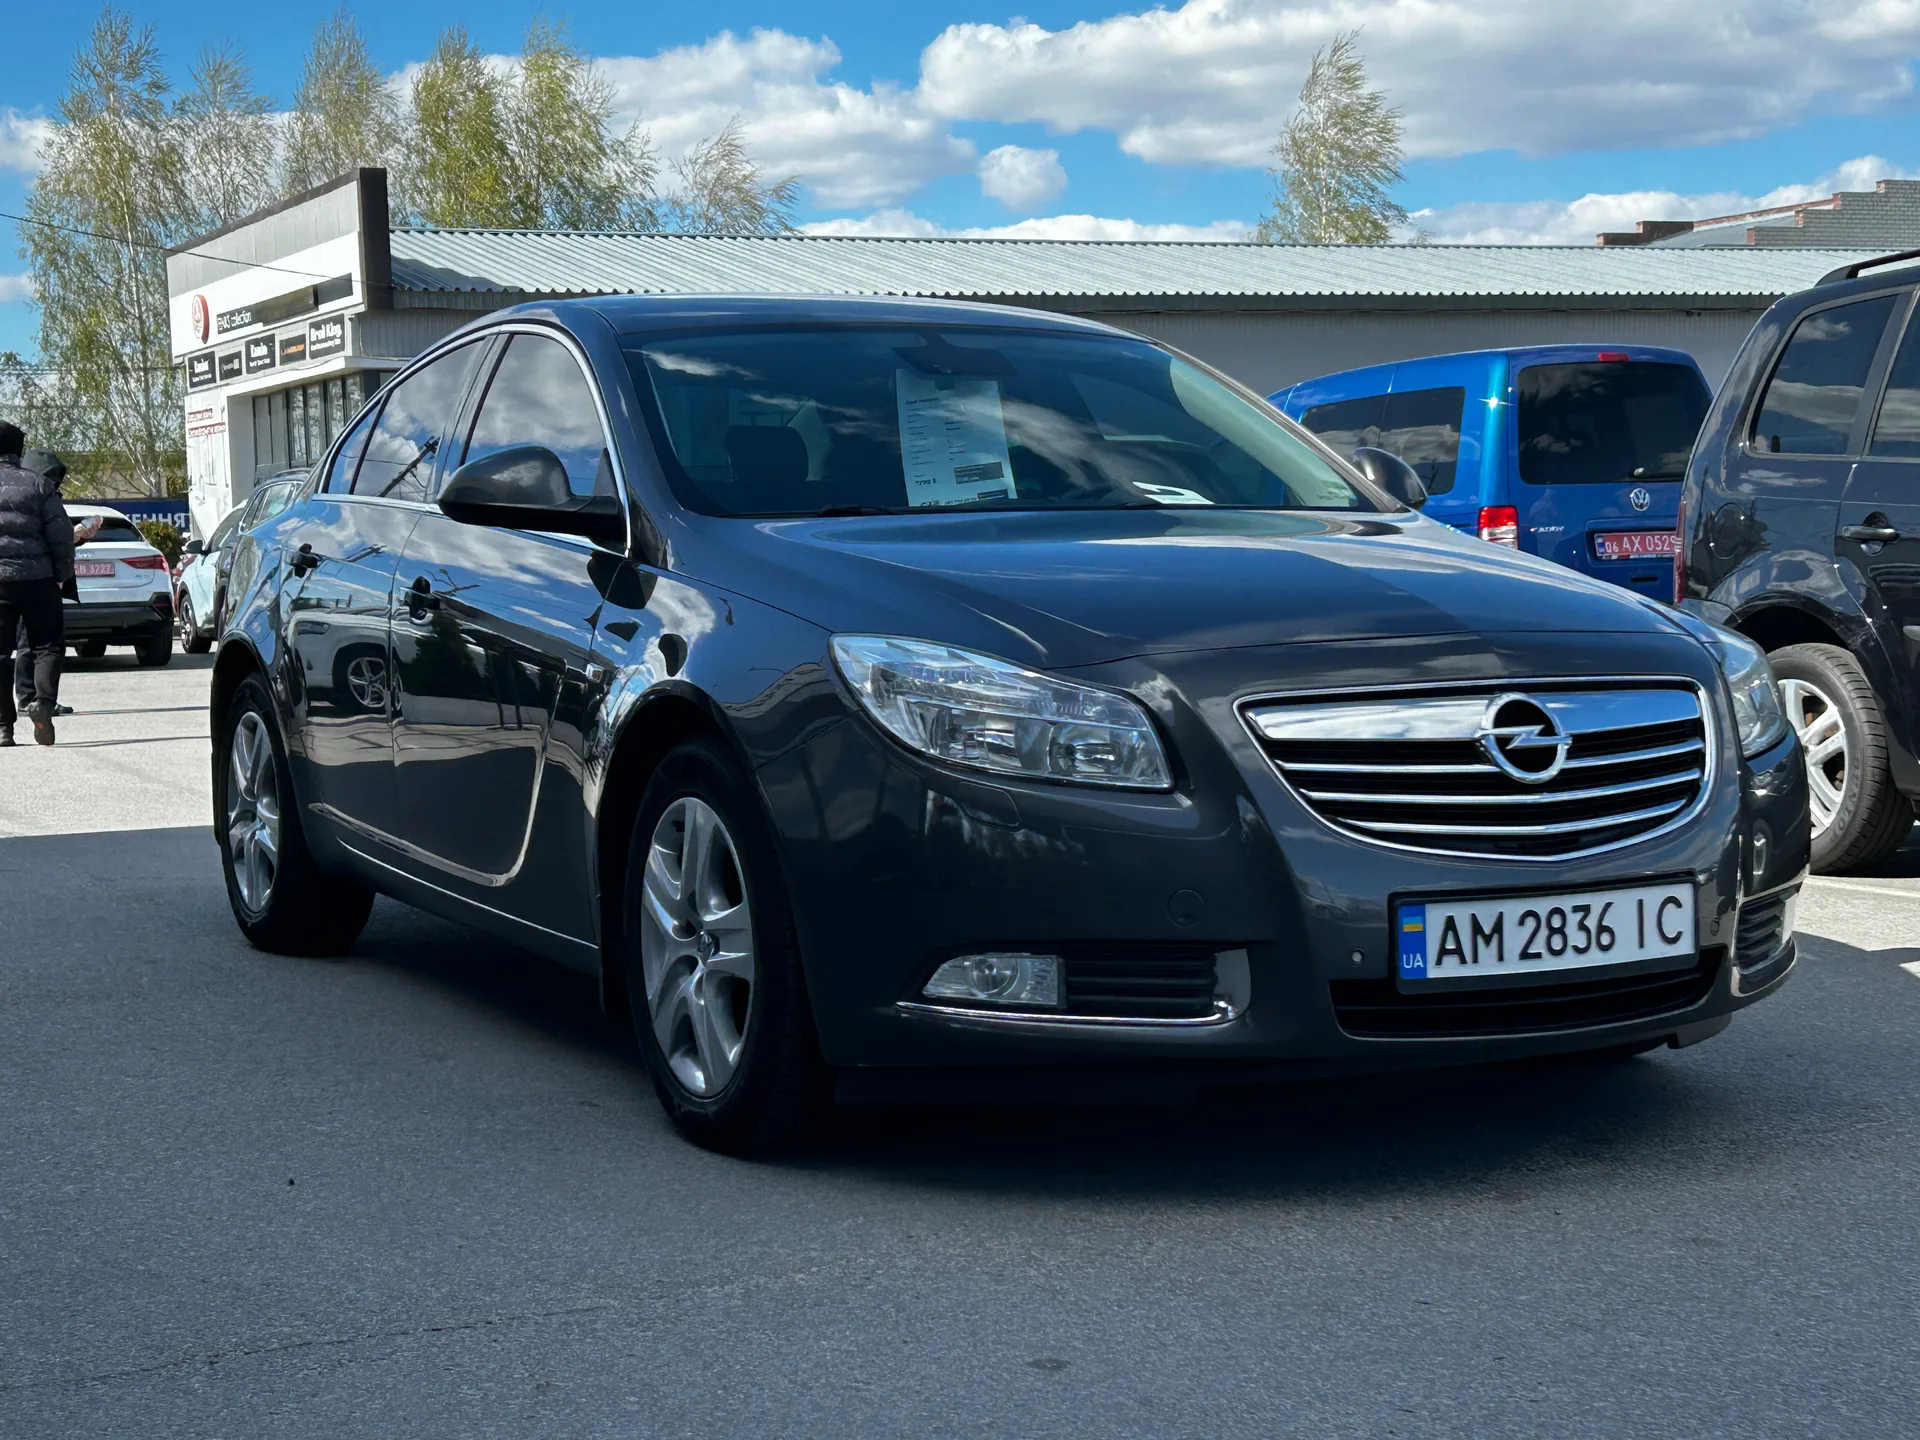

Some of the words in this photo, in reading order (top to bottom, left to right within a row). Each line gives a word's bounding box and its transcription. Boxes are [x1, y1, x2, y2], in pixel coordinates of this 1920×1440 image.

[127, 513, 186, 528] ЕННЯ
[1604, 541, 1619, 553] 06
[1622, 535, 1643, 552] AX
[1434, 910, 1504, 967] AM
[1518, 900, 1616, 961] 2836
[1637, 895, 1684, 950] IC
[1403, 953, 1424, 969] UA
